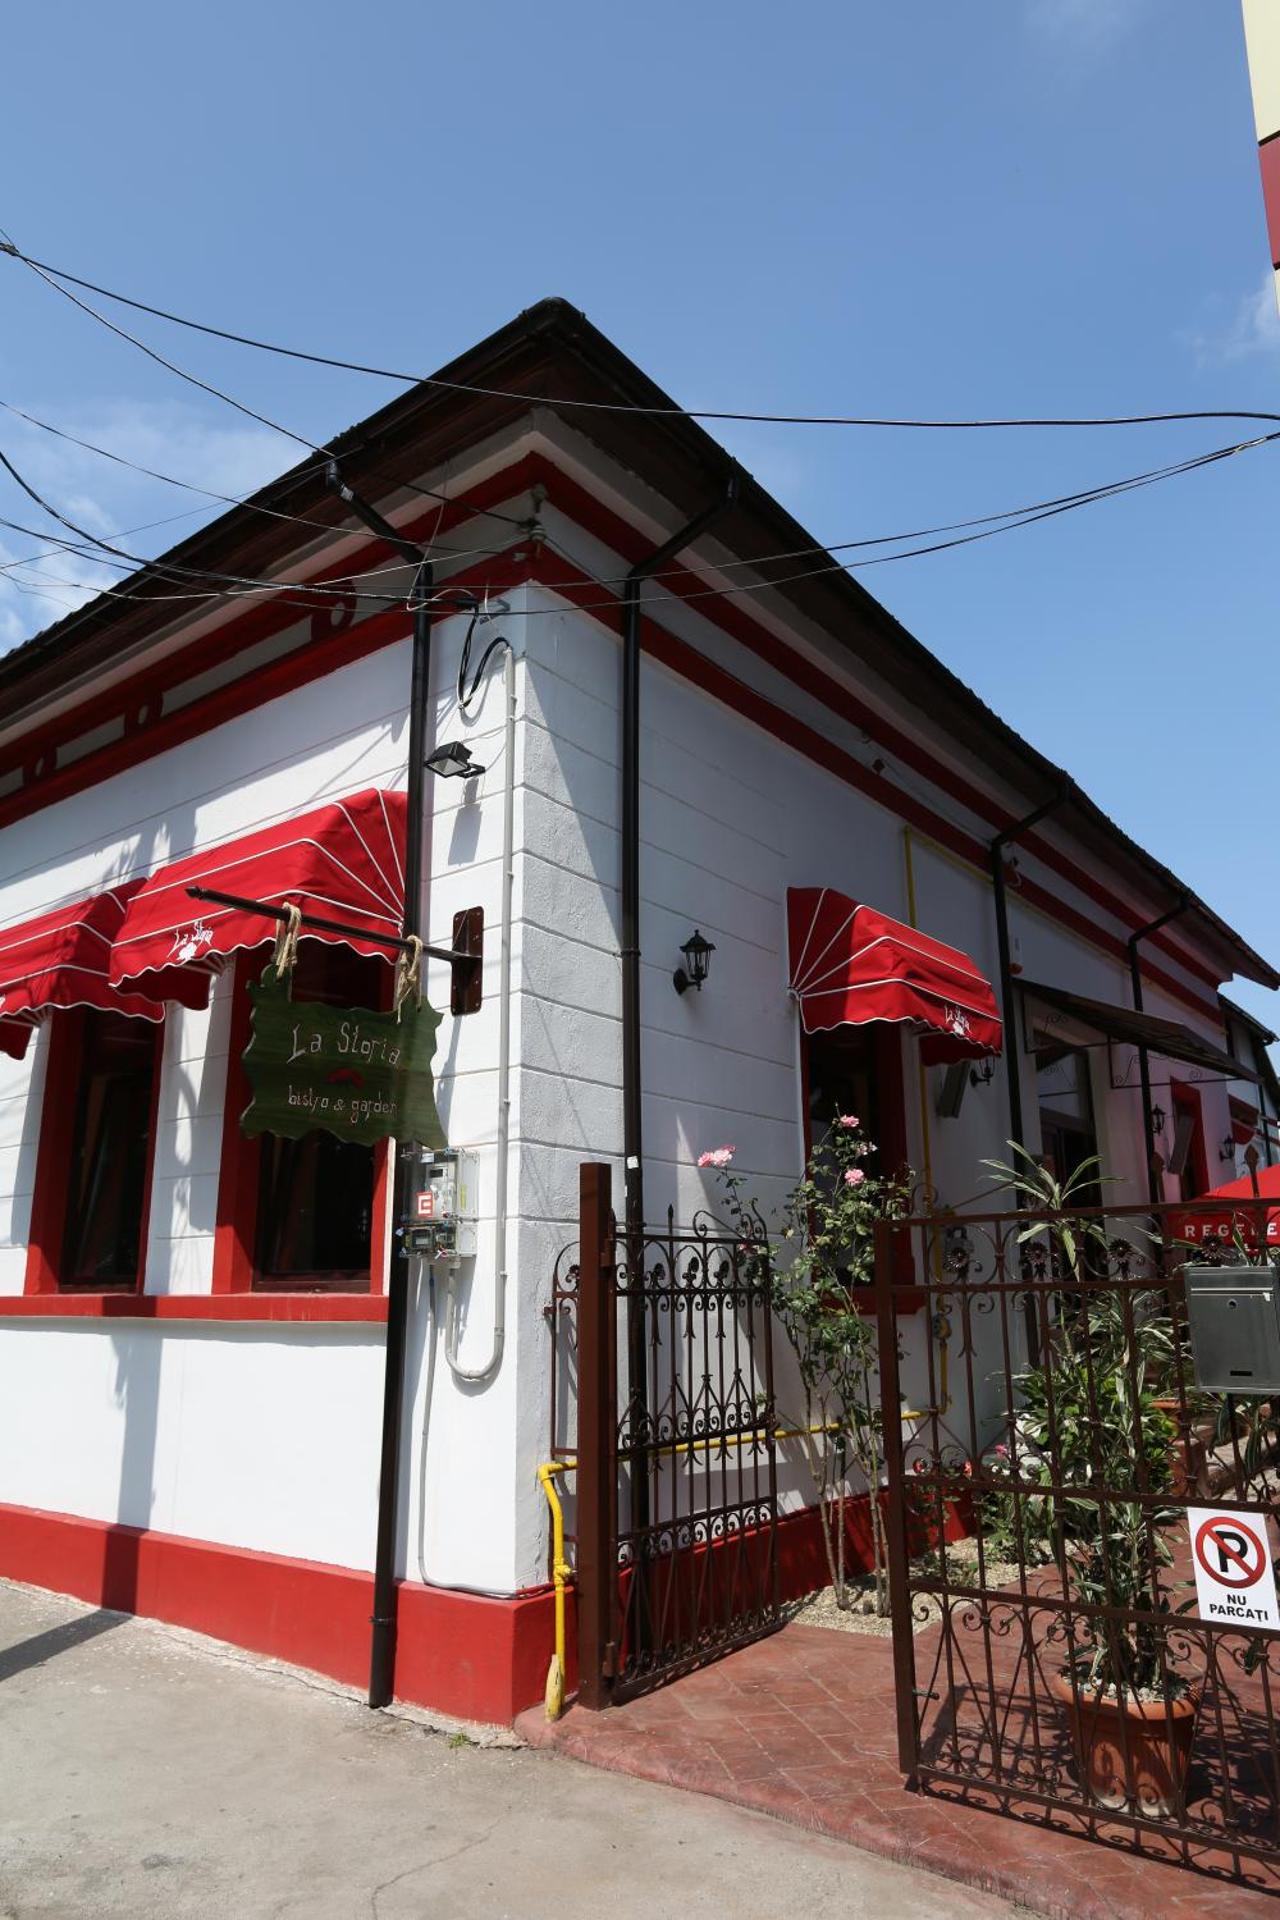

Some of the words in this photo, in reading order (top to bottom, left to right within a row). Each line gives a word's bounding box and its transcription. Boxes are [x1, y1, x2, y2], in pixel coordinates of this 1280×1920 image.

[286, 1023, 323, 1064] La
[337, 1022, 401, 1068] Storia
[333, 1099, 345, 1111] &
[350, 1091, 398, 1123] garden
[1226, 1594, 1247, 1606] NU
